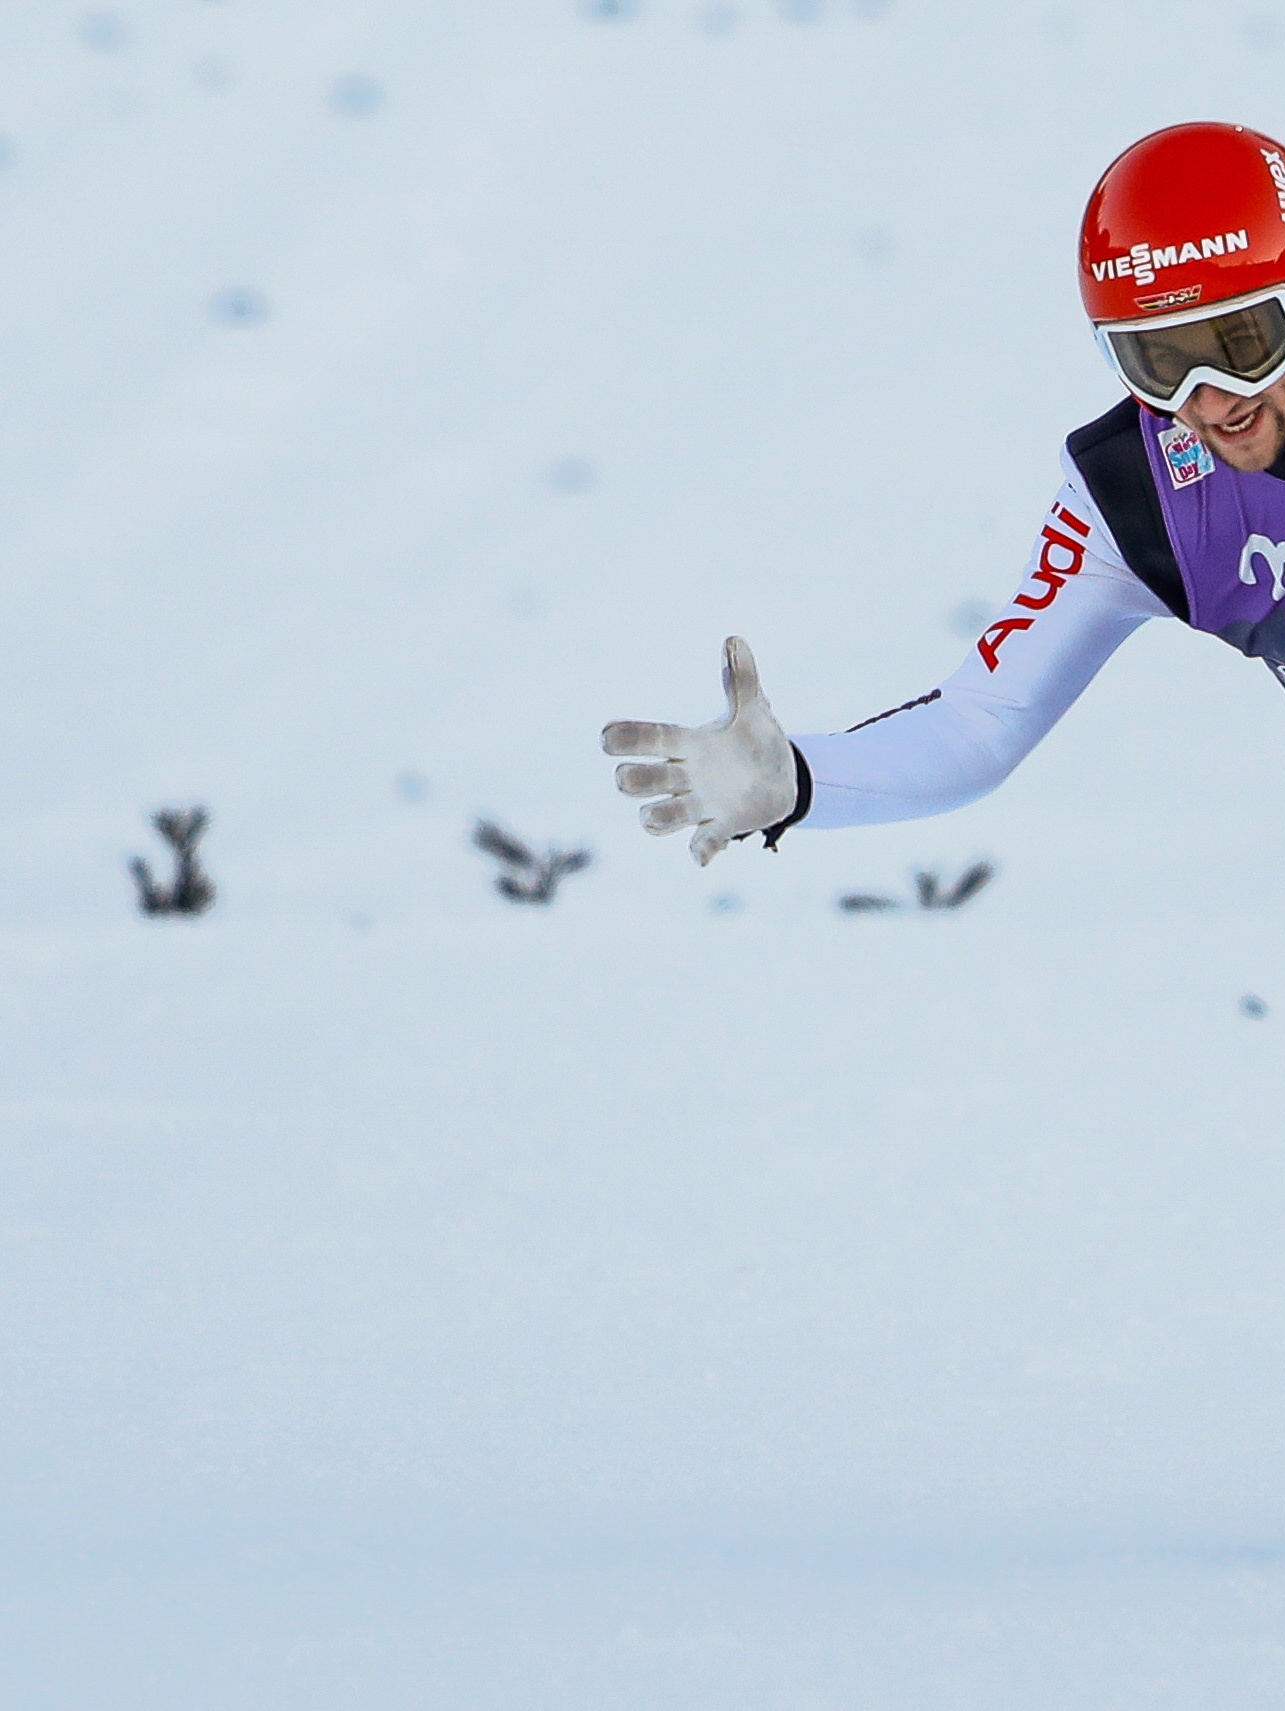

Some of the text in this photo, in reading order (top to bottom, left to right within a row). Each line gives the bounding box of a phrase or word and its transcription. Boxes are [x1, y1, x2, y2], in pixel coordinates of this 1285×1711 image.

[1091, 229, 1249, 287] VIESSMANN
[1178, 461, 1200, 480] Day
[976, 500, 1092, 674] Audi
